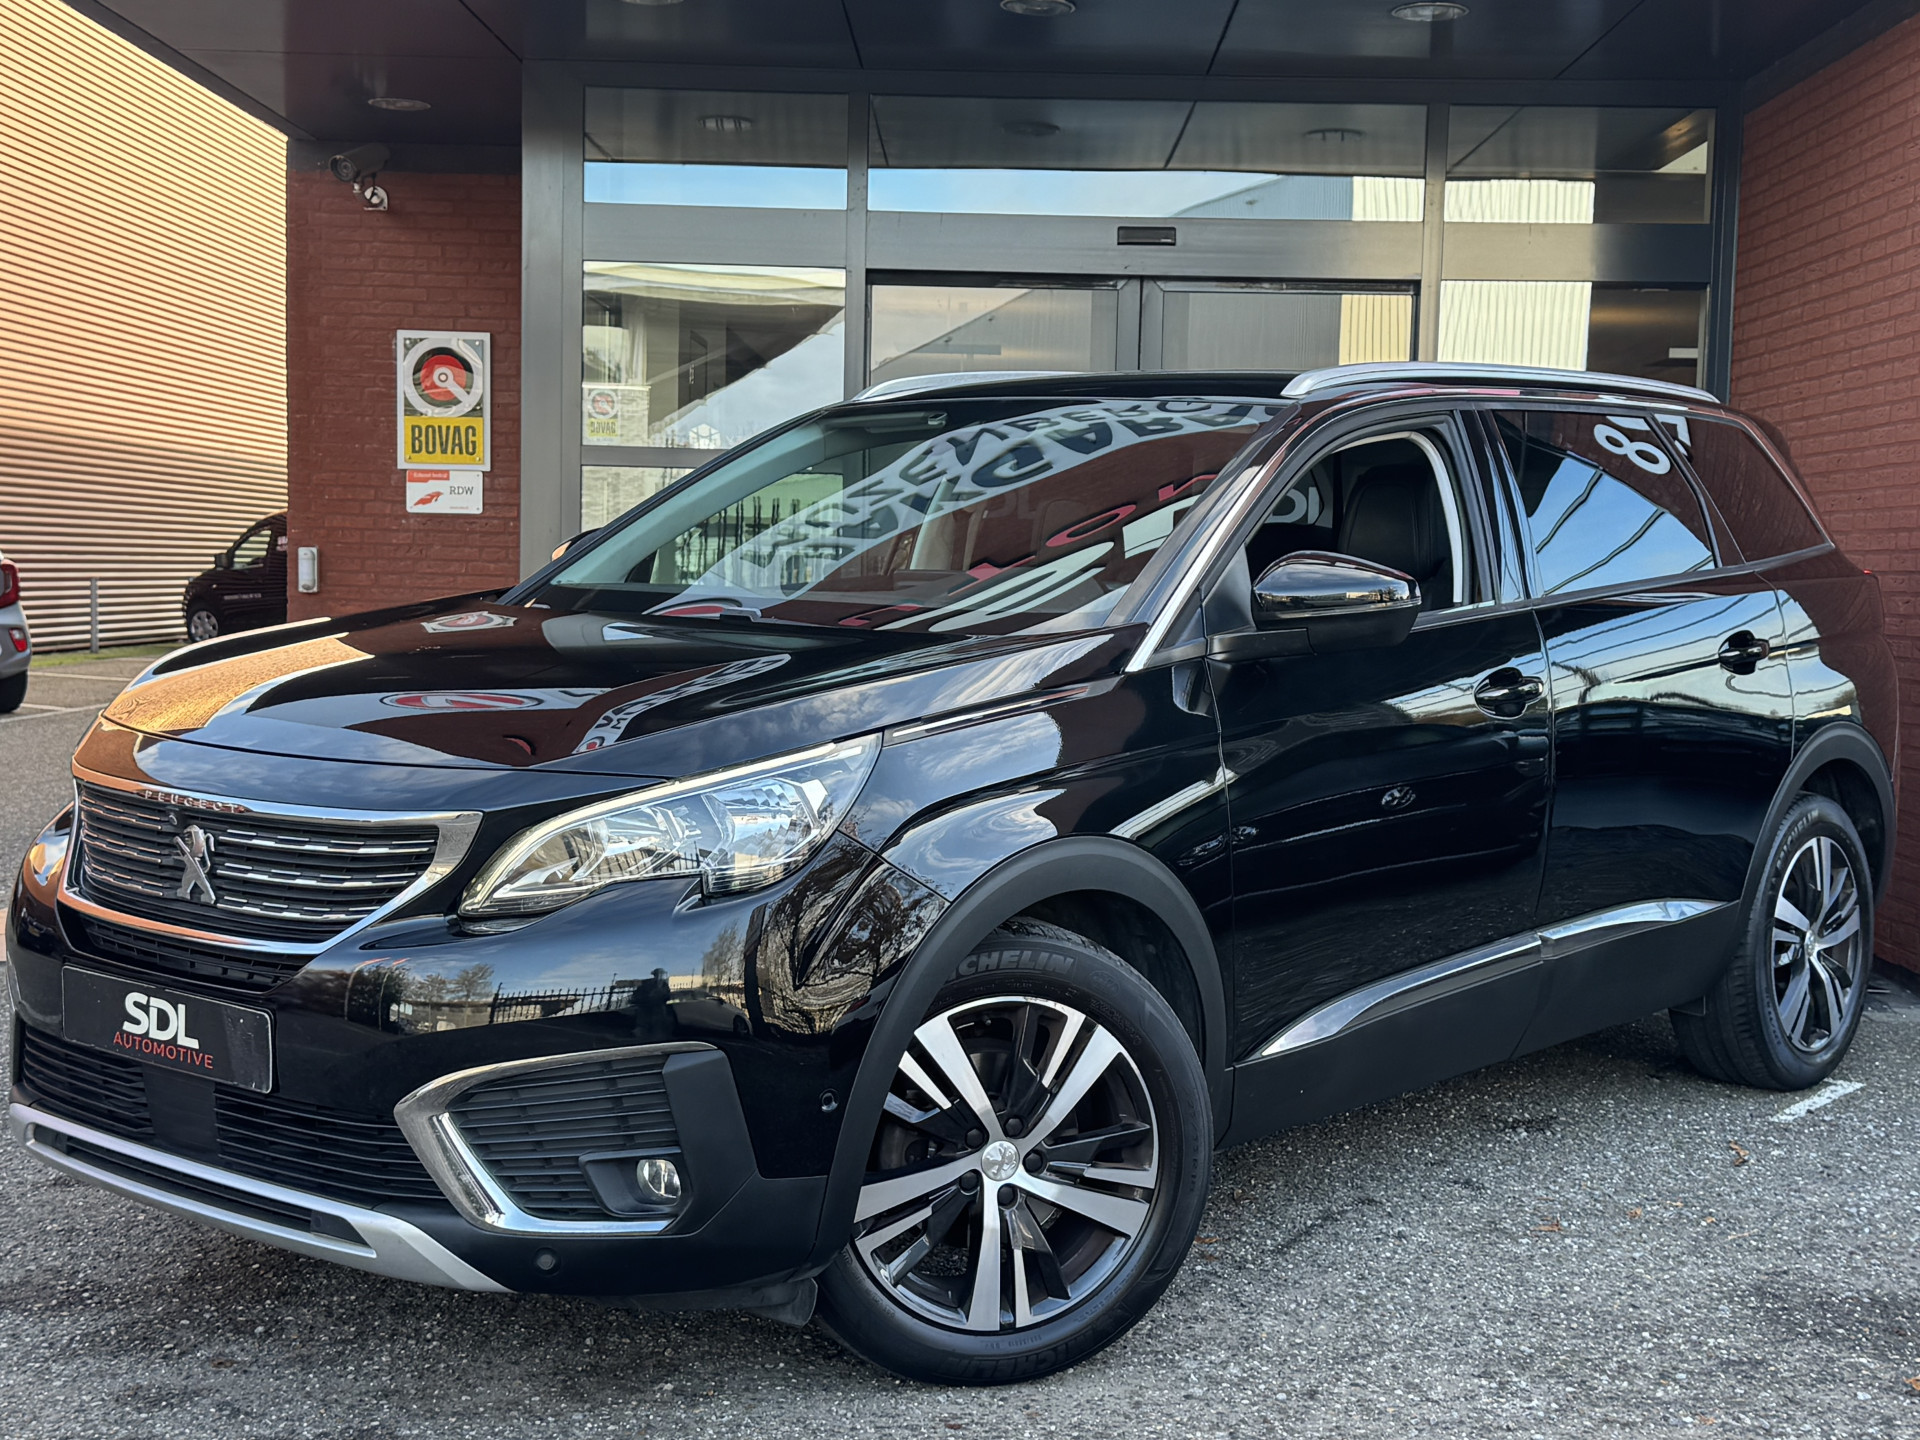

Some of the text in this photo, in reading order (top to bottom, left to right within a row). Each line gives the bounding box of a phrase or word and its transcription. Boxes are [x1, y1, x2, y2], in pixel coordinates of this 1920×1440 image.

[411, 424, 477, 456] BOVAG
[449, 486, 474, 495] RDW
[145, 790, 238, 813] PEUGEOT
[950, 949, 1074, 978] CHELIN
[122, 992, 200, 1049] SDL
[113, 1031, 214, 1069] AUTOMOTIVE
